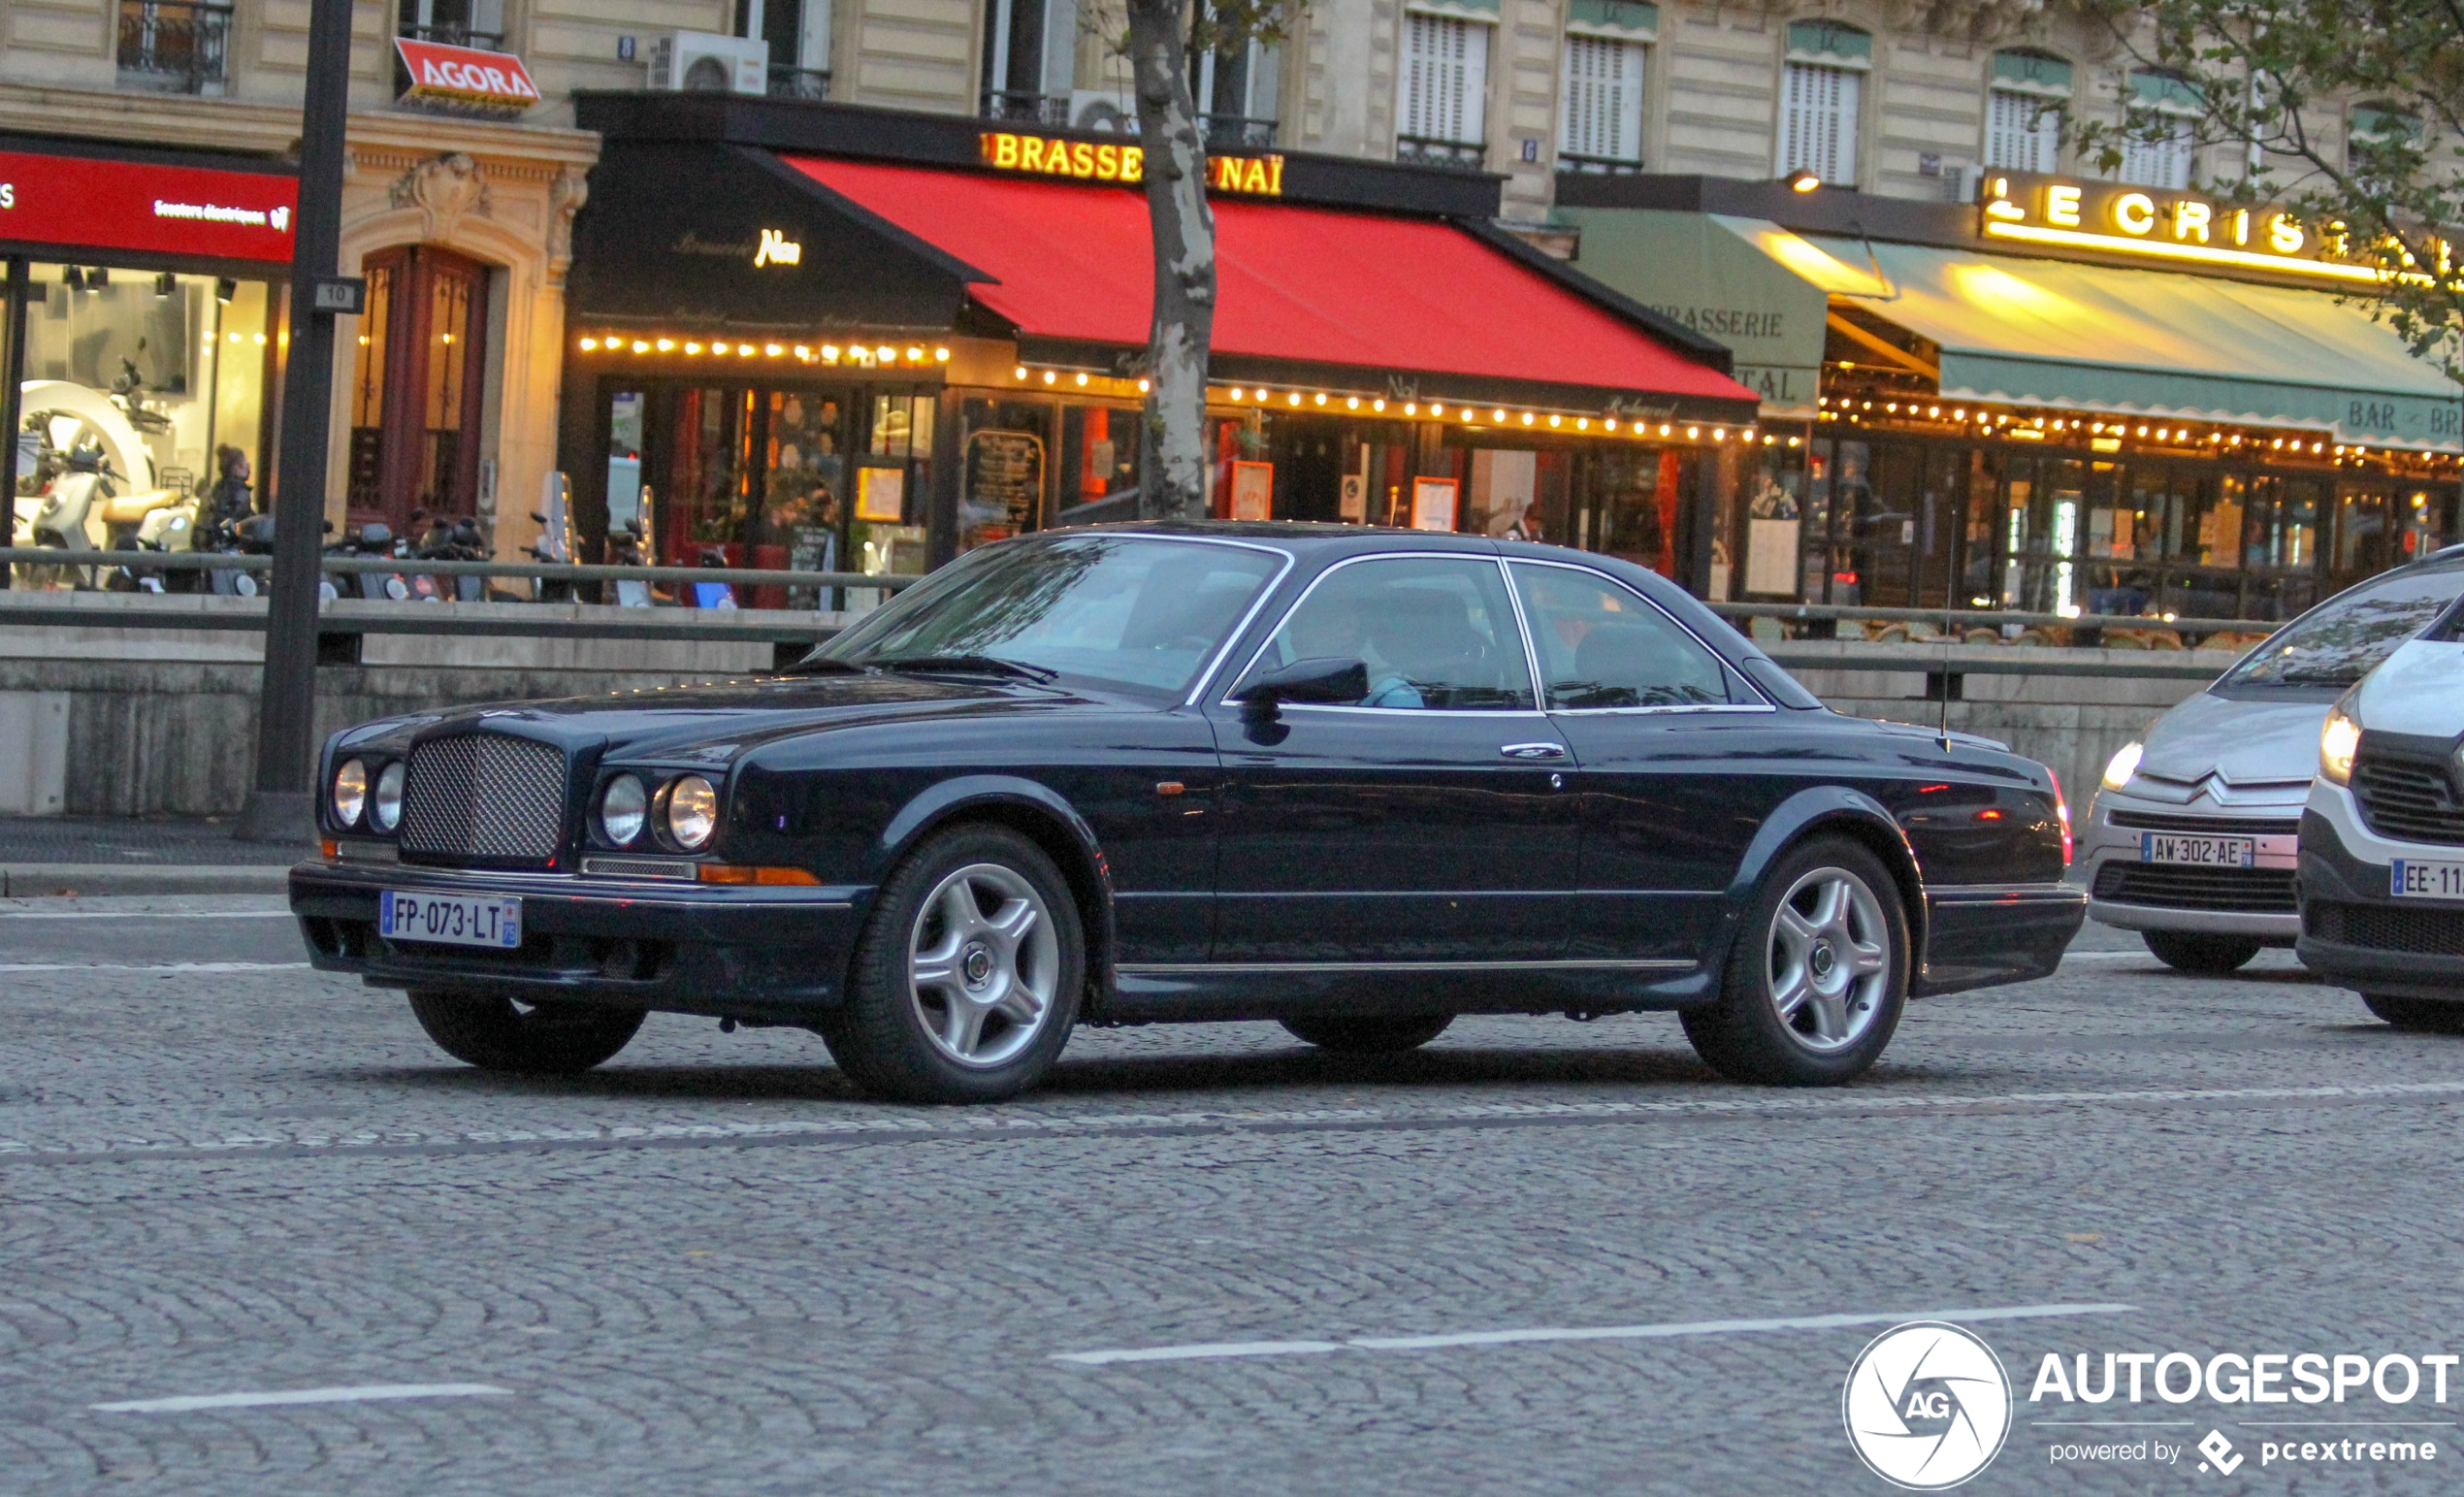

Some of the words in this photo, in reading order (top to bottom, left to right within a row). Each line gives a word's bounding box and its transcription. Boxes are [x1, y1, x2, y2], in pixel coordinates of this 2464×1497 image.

[422, 57, 535, 96] AGORA
[991, 132, 1144, 182] BRASSE
[1986, 178, 2082, 228] LE
[327, 284, 346, 302] 10
[2349, 400, 2395, 430] BAR
[2431, 407, 2464, 437] BR
[2156, 837, 2239, 864] AW-302-AE
[2406, 865, 2464, 895] EE-11
[395, 897, 501, 940] FP-073-LT
